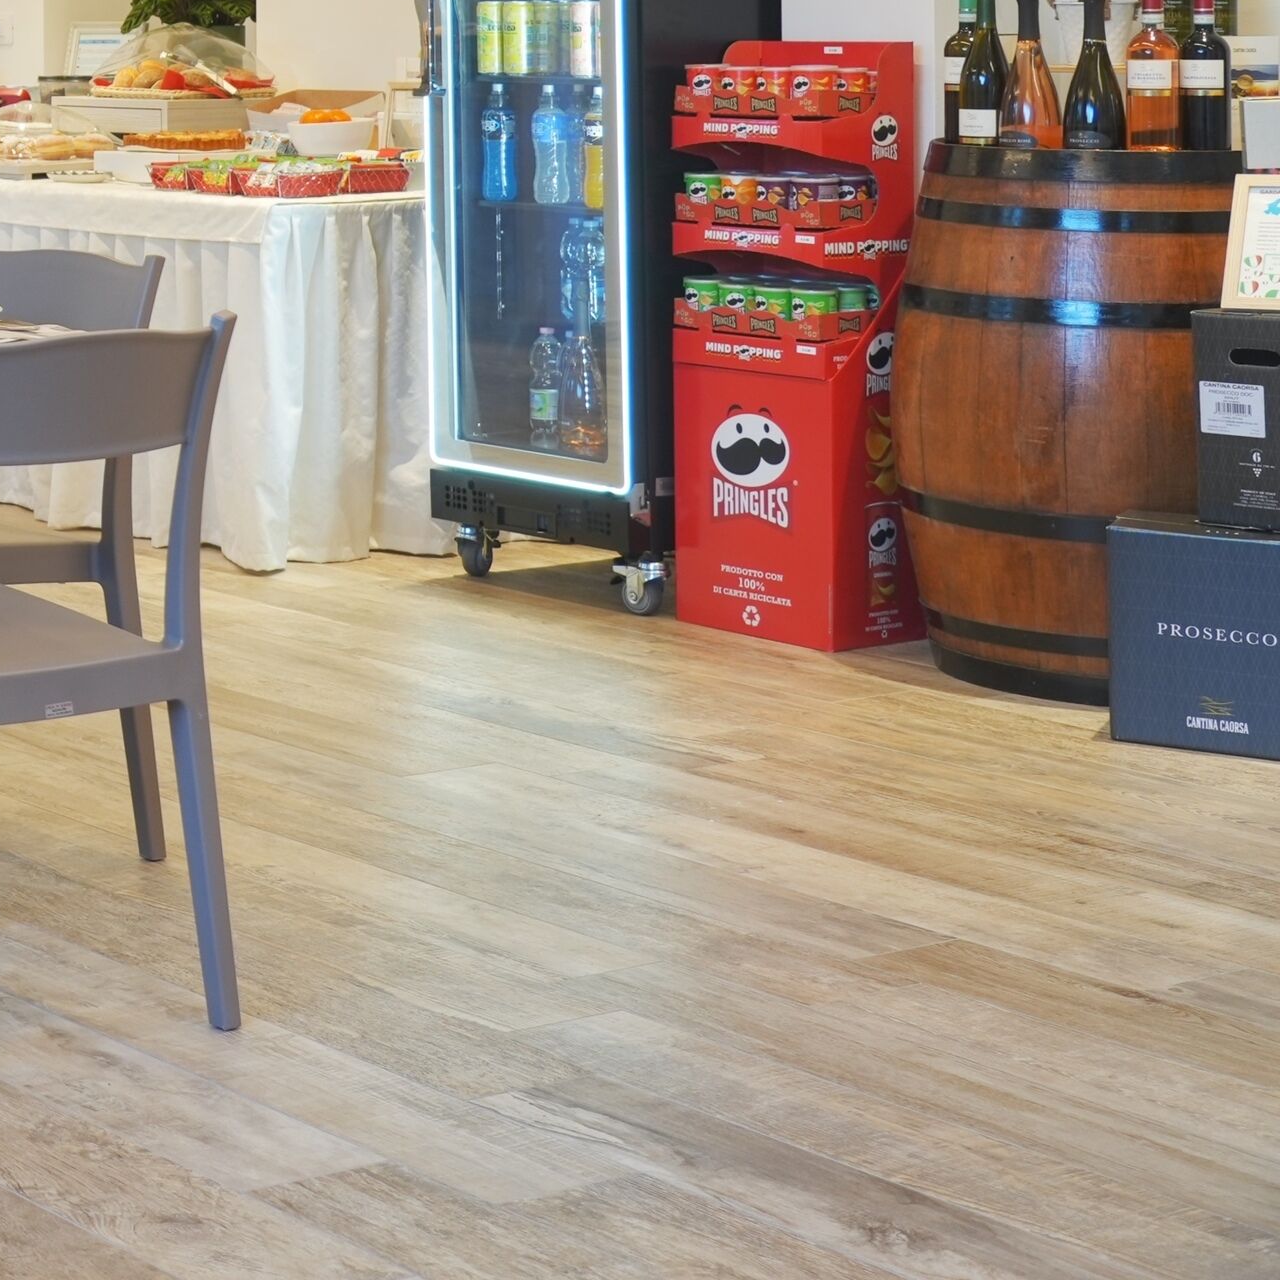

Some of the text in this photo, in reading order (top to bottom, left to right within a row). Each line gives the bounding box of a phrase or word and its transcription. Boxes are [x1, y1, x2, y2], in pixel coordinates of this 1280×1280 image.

[714, 97, 738, 111] PRINGLES
[751, 98, 776, 112] PRINGLES
[703, 122, 729, 133] MIND
[871, 143, 898, 161] PRINGLES
[714, 206, 738, 220] PRINGLES
[752, 208, 777, 222] PRINGLES
[704, 230, 730, 241] MIND
[824, 242, 854, 255] MIND
[712, 313, 737, 328] PRINGLES
[750, 318, 775, 332] PRINGLES
[705, 342, 731, 354] MIND
[1252, 451, 1262, 463] 6
[713, 477, 789, 528] PRINGLES
[868, 547, 897, 568] PRINGLES
[720, 564, 784, 582] PRODOTTO CON
[738, 577, 765, 591] 100%
[713, 585, 792, 606] DI CARTA RICICLATA
[1156, 622, 1278, 647] PROSECCO
[1186, 715, 1249, 735] CANTINA CAORSA
